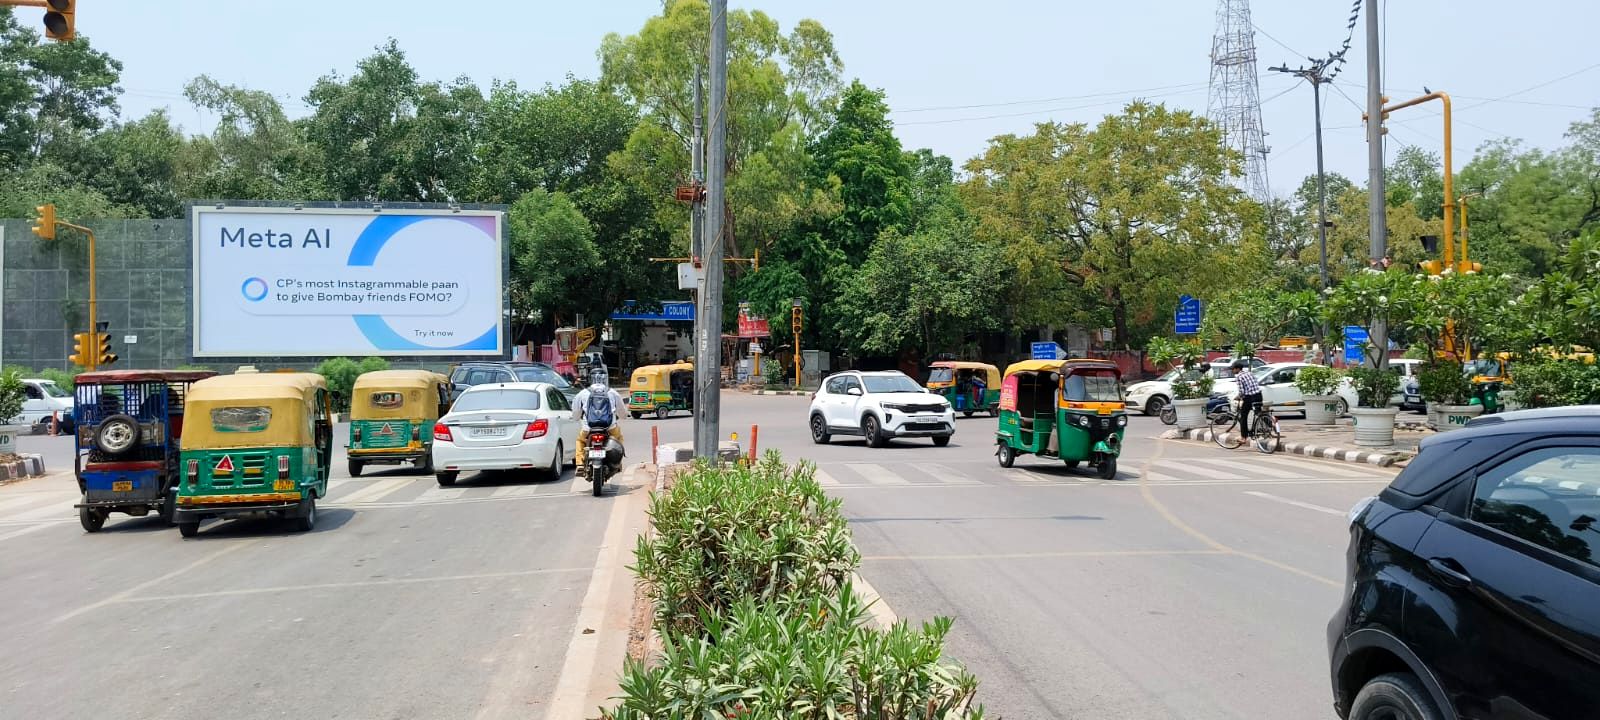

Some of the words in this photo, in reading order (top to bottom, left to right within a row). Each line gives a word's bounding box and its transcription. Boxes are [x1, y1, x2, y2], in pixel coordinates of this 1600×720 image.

[220, 226, 293, 249] Meta
[302, 228, 331, 249] AI
[276, 278, 303, 289] CP's
[305, 279, 335, 289] most
[337, 279, 429, 291] Instagrammable
[431, 281, 459, 291] paan
[276, 292, 289, 302] to
[291, 292, 315, 304] give
[317, 291, 365, 304] Bombay
[366, 291, 407, 302] friends
[409, 292, 452, 303] FOMO?
[414, 329, 427, 339] Try
[429, 329, 435, 337] it
